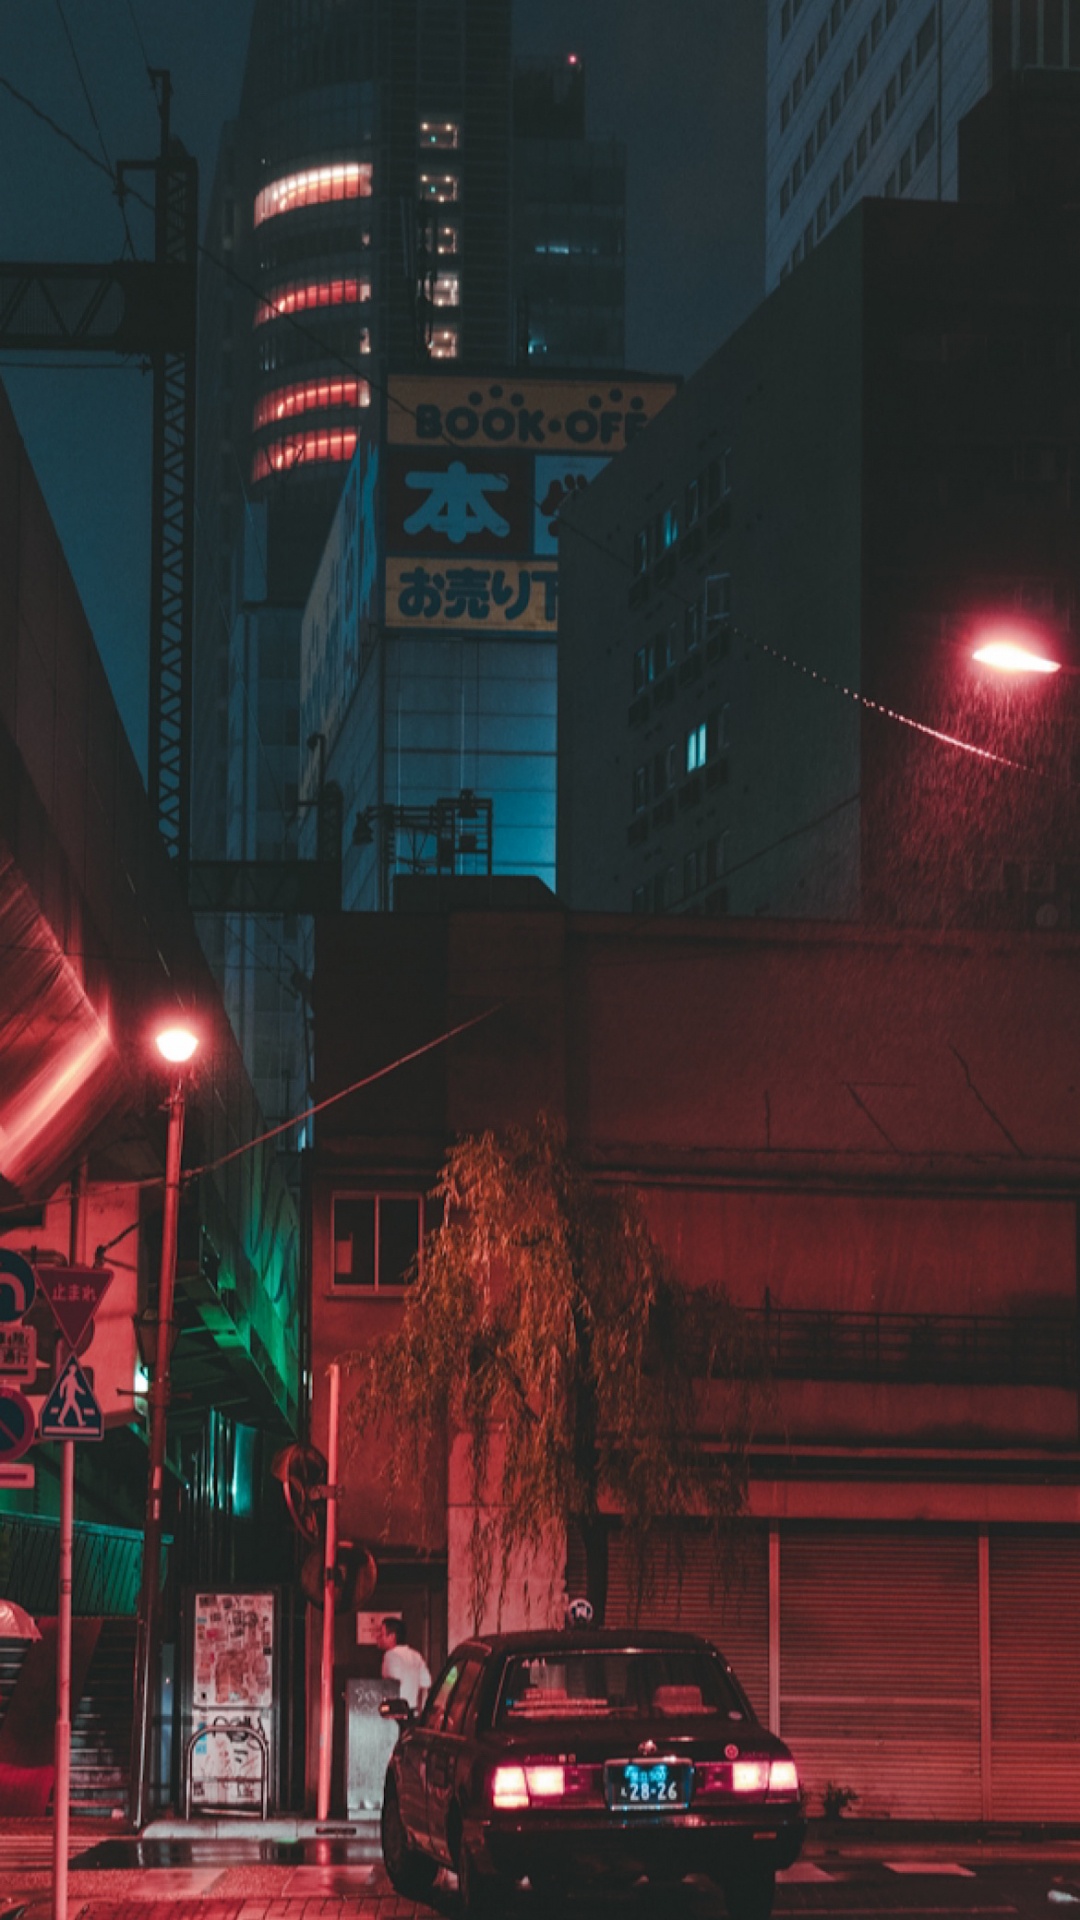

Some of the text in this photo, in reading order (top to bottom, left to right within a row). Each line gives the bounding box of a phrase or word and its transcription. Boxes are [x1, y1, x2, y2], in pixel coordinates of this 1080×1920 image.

[403, 461, 510, 543] 本
[52, 1282, 97, 1301] 止まれ
